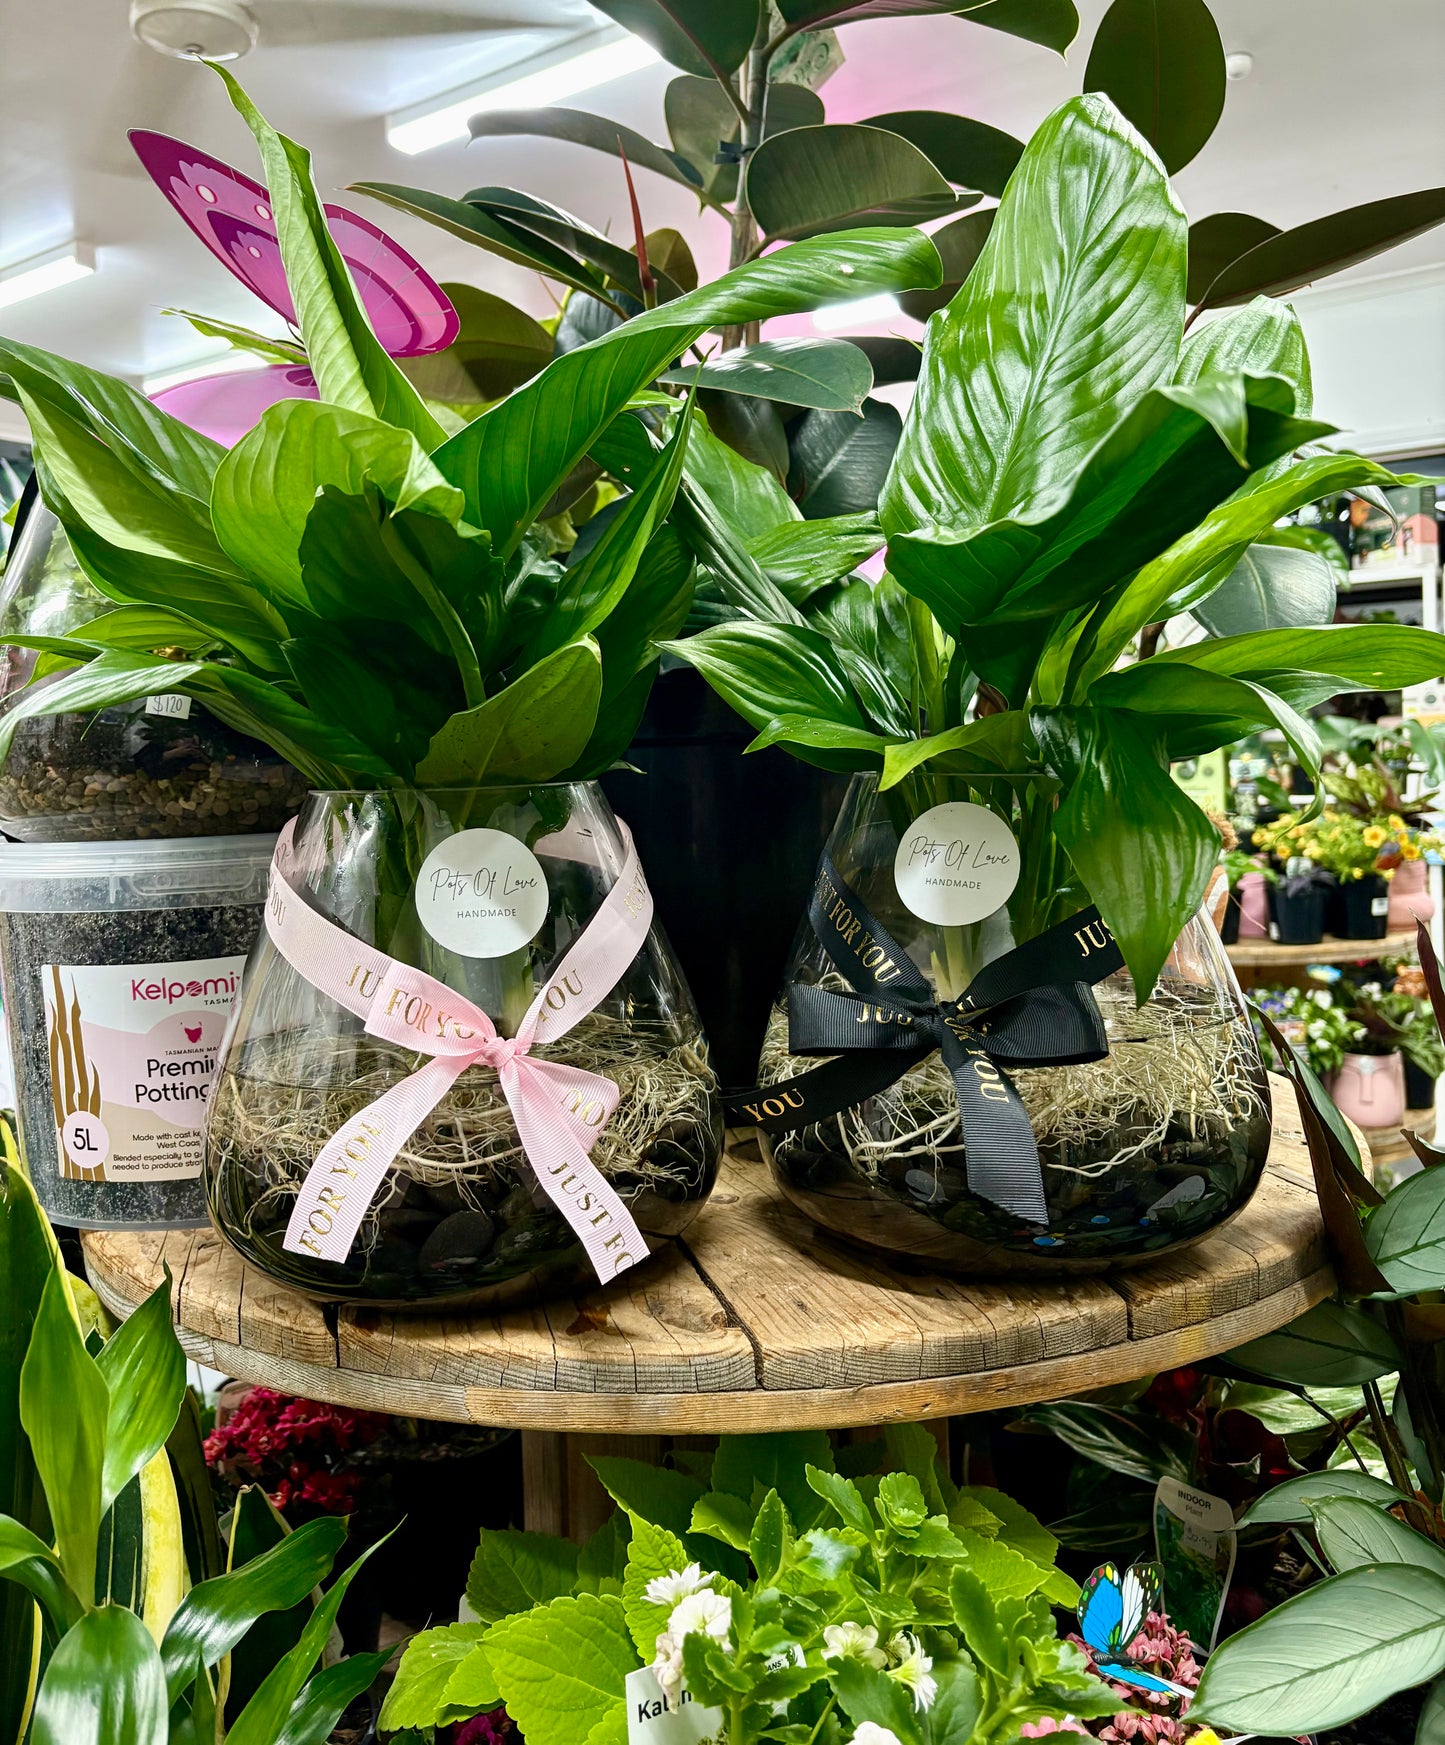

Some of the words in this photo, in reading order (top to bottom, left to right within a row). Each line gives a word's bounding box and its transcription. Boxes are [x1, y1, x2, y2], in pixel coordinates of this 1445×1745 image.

[152, 695, 183, 715] $120
[908, 835, 946, 868] Pots
[944, 839, 970, 871] Of
[972, 840, 1010, 869] Love
[429, 867, 472, 901] Pots
[473, 867, 496, 900] Of
[503, 865, 538, 895] Love
[925, 877, 982, 890] HANDMADE
[457, 907, 517, 919] HANDMADE
[828, 897, 861, 946] FOR
[854, 931, 901, 983] YOU
[131, 971, 241, 1005] Kelpomi
[384, 988, 433, 1034] FOR
[165, 1048, 204, 1056] TASMANIAN
[741, 1087, 805, 1122] YOU
[73, 1127, 99, 1151] 5L
[156, 1132, 172, 1140] with
[174, 1131, 191, 1139] cast
[156, 1141, 177, 1149] West
[142, 1162, 150, 1170] to
[151, 1160, 184, 1171] produce
[143, 1151, 182, 1162] especially
[298, 1186, 347, 1256] FOR
[329, 1111, 387, 1182] YOU
[547, 1161, 614, 1228] JUST
[1177, 1489, 1212, 1511] INDOOR
